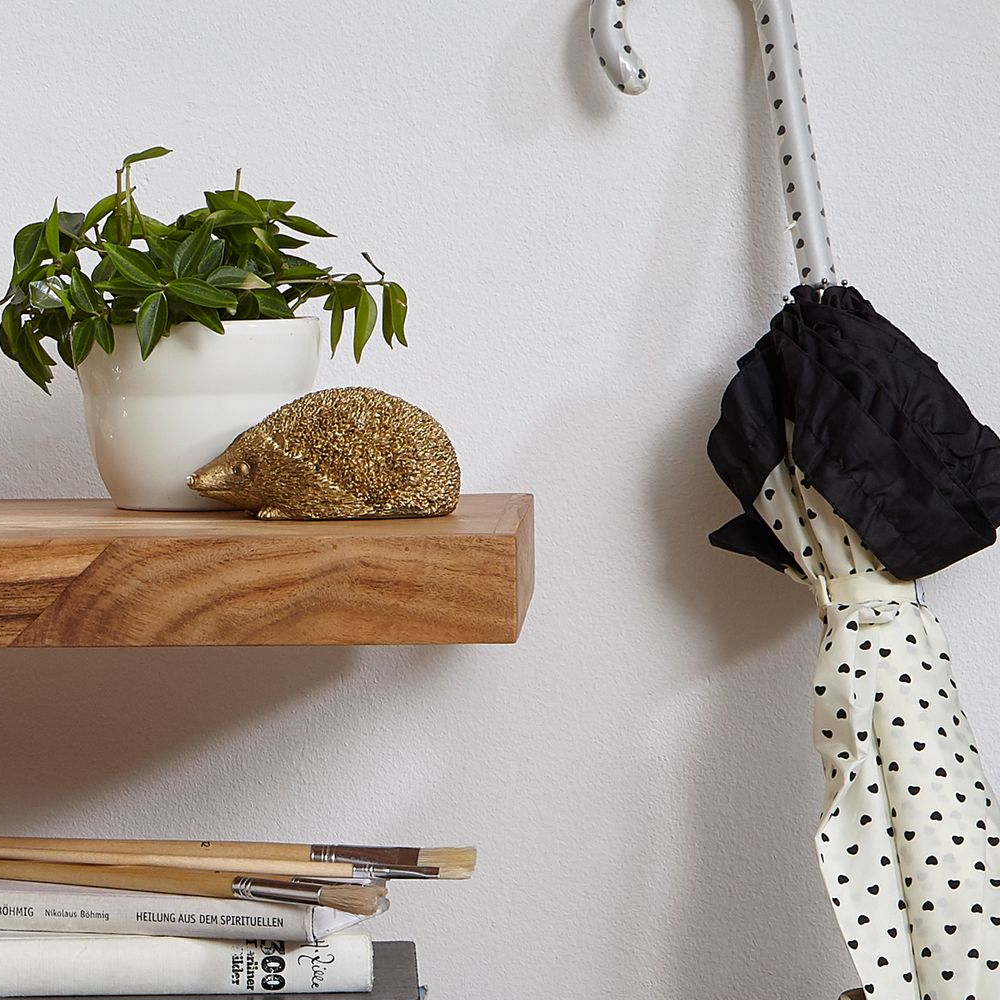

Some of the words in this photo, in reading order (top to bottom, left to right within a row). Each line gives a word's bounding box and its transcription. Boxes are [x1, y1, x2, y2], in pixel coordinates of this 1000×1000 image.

[45, 909, 78, 918] Nikolaus
[80, 910, 110, 921] Böhmig
[136, 912, 176, 923] HEILUNG
[178, 913, 196, 924] AUS
[199, 914, 218, 925] DEM
[220, 915, 284, 928] SPIRITUELLEN
